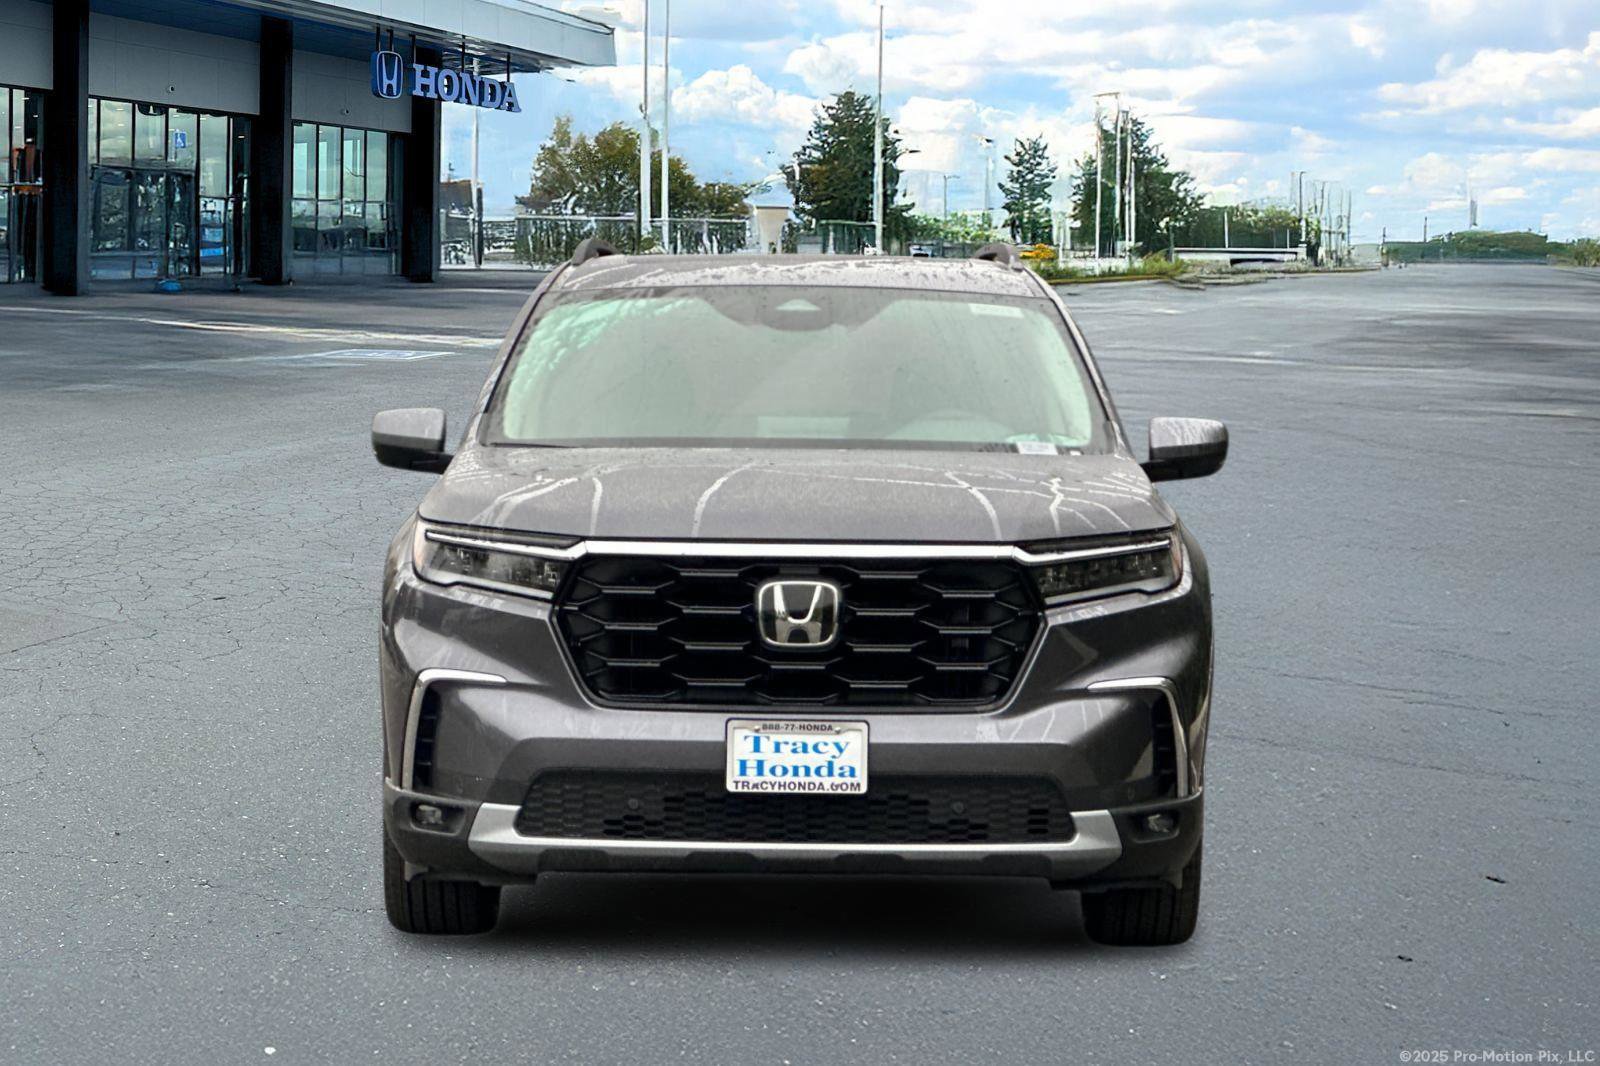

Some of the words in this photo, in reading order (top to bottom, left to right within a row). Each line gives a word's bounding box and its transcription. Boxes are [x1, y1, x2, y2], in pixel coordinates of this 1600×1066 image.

[411, 63, 522, 113] HONDA
[743, 735, 850, 760] Tracy
[736, 758, 857, 779] Honda
[732, 780, 861, 792] TRACYHONDA.COM
